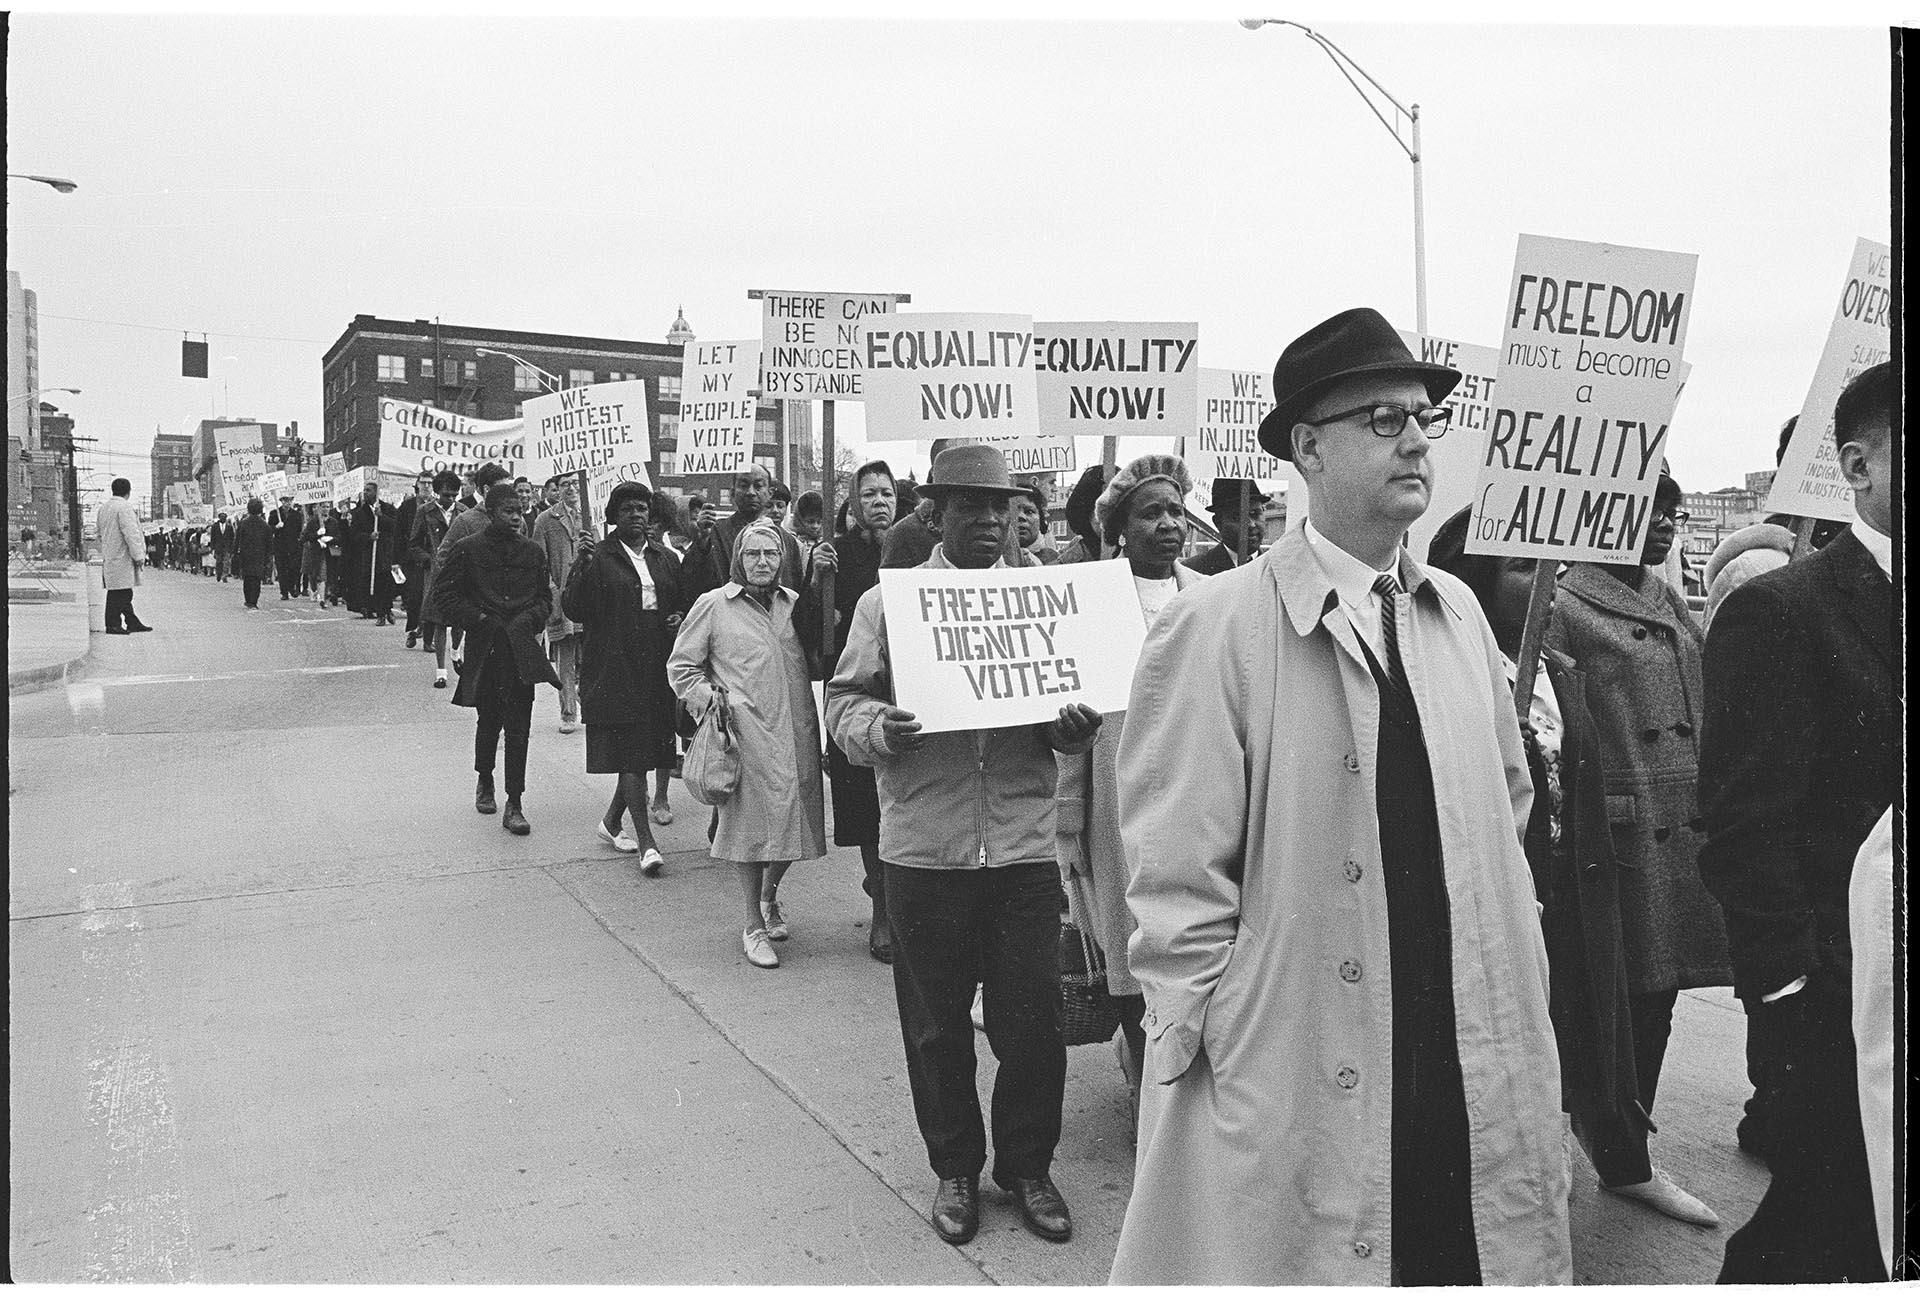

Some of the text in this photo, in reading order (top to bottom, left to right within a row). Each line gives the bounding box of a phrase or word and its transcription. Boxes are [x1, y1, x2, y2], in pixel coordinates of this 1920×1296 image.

[1868, 251, 1890, 278] WE
[767, 295, 888, 320] THERE CAN
[1512, 274, 1685, 345] FREEDOM
[1842, 278, 1891, 327] OVER
[785, 322, 816, 344] BE
[698, 345, 737, 366] LET
[772, 346, 864, 370] INNOCEN
[866, 330, 1033, 371] EQUALITY
[1033, 337, 1198, 374] EQUALITY
[1421, 337, 1459, 368] WE
[1507, 338, 1672, 380] must become
[702, 372, 733, 393] MY
[766, 371, 865, 395] BYSTANDE
[1231, 372, 1262, 399] WE
[1575, 384, 1593, 403] a
[560, 387, 591, 411] WE
[681, 400, 752, 422] PEOPLE
[920, 383, 1014, 421] NOW!
[1069, 385, 1166, 421] NOW!
[381, 401, 478, 436] Catholic
[541, 403, 624, 437] PROTEST
[401, 428, 525, 460] Interracia
[537, 425, 634, 460] INJUSTICE
[692, 427, 744, 448] VOTE
[1199, 427, 1263, 454] INJUS
[1485, 408, 1668, 481] REALITY
[238, 457, 254, 472] for
[553, 447, 614, 475] NAACP
[682, 451, 745, 473] NAACP
[1003, 446, 1071, 472] EQUALITY
[1216, 455, 1279, 480] NAACP
[221, 469, 263, 485] Freedom
[1798, 479, 1852, 502] INJUSTICE
[307, 489, 330, 500] NOW!
[1473, 482, 1650, 551] for ALL MEN
[918, 581, 1079, 623] FREEDOM
[932, 621, 1057, 662] DIGNITY
[960, 657, 1082, 701] VOTES
